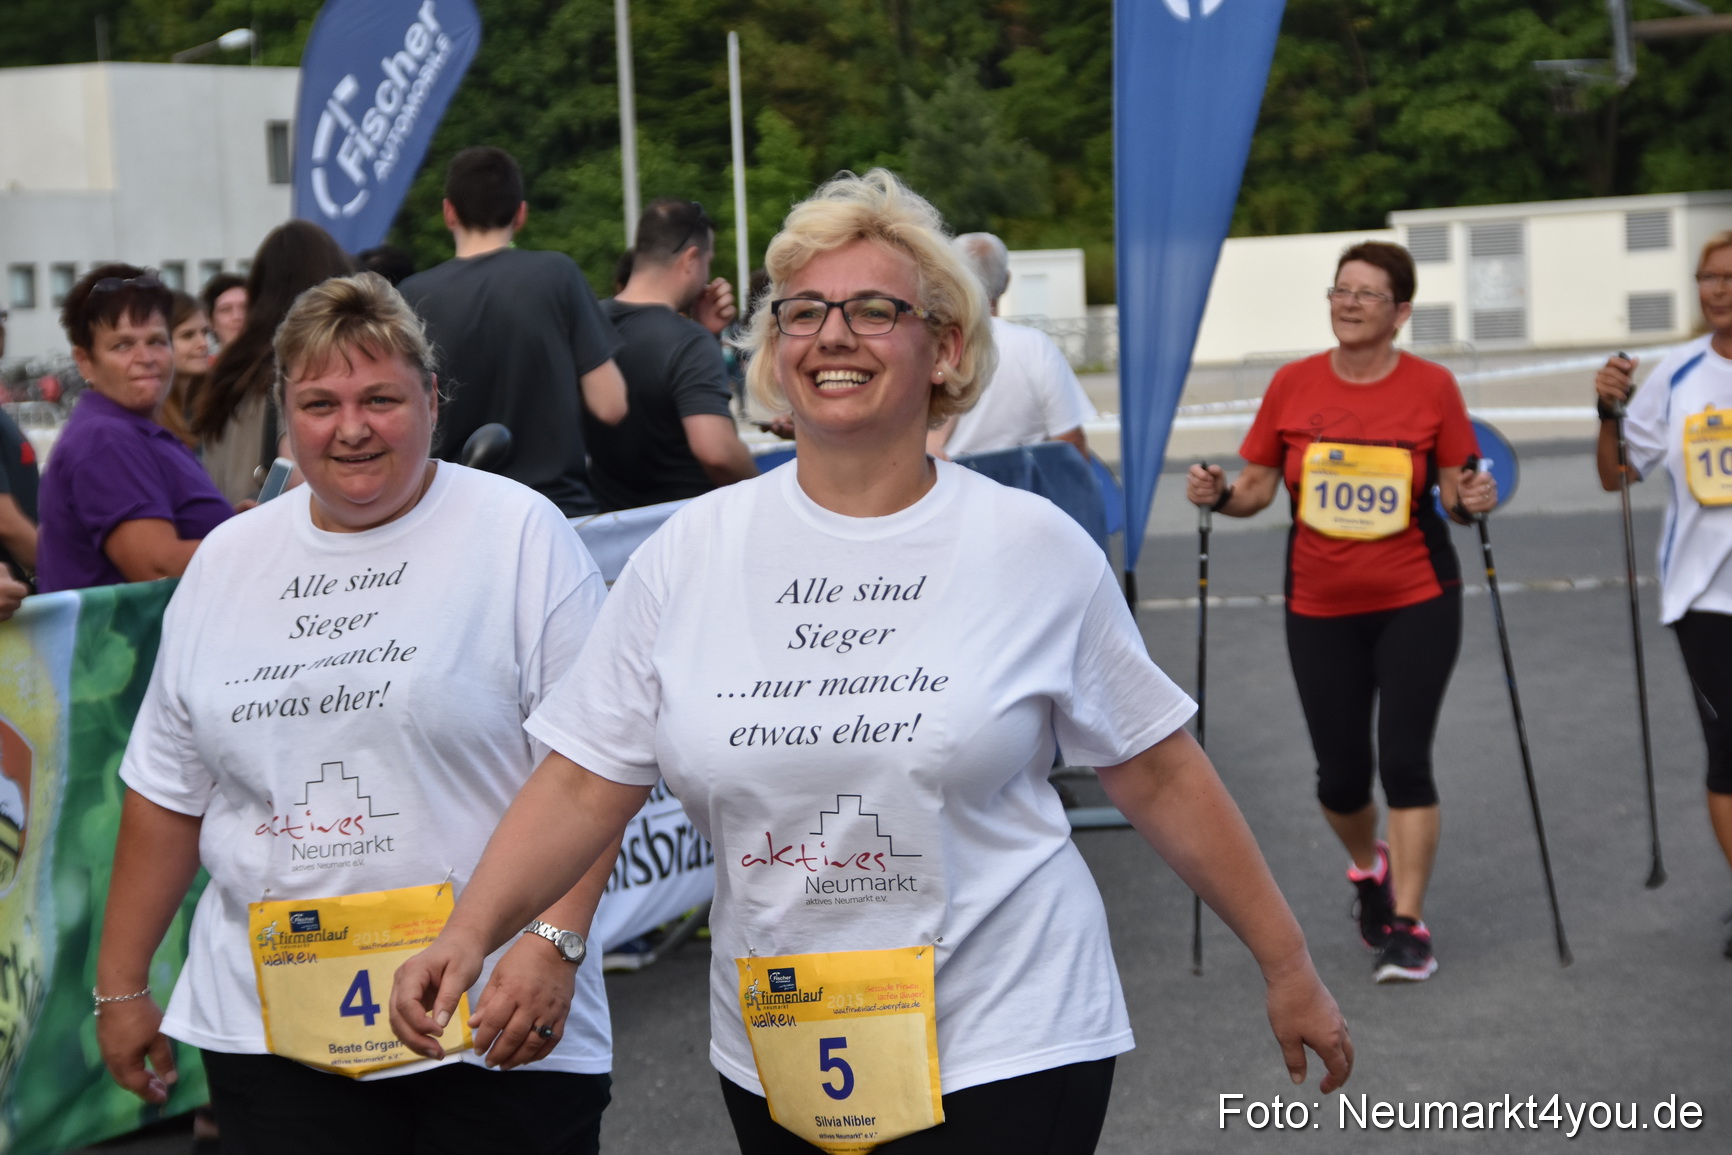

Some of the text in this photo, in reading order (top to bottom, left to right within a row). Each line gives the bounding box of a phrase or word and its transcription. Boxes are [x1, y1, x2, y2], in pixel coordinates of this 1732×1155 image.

[336, 0, 441, 188] Fischer
[1314, 480, 1399, 515] 1099
[279, 561, 408, 600] Alle sind
[775, 575, 927, 604] Alle sind
[288, 611, 379, 640] Sieger
[787, 623, 896, 654] Sieger
[225, 639, 417, 686] ...nur manche
[717, 666, 949, 698] ...nur manche
[231, 680, 391, 723] etwas eher!
[729, 712, 922, 747] etwas eher!
[291, 835, 395, 861] Neumarkt
[742, 831, 886, 872] aktives
[805, 874, 918, 894] Neumarkt
[805, 897, 832, 905] aktives
[835, 895, 873, 905] Neumarkt
[279, 926, 349, 945] firmenlauf
[352, 929, 391, 946] 2015
[263, 951, 318, 966] walken
[339, 969, 381, 1026] 4
[761, 987, 823, 1004] firmenlauf
[827, 993, 864, 1008] 2015
[750, 1012, 796, 1028] walken
[328, 1043, 362, 1054] Beate
[819, 1036, 855, 1101] 5
[815, 1115, 876, 1127] Silvia Nibler
